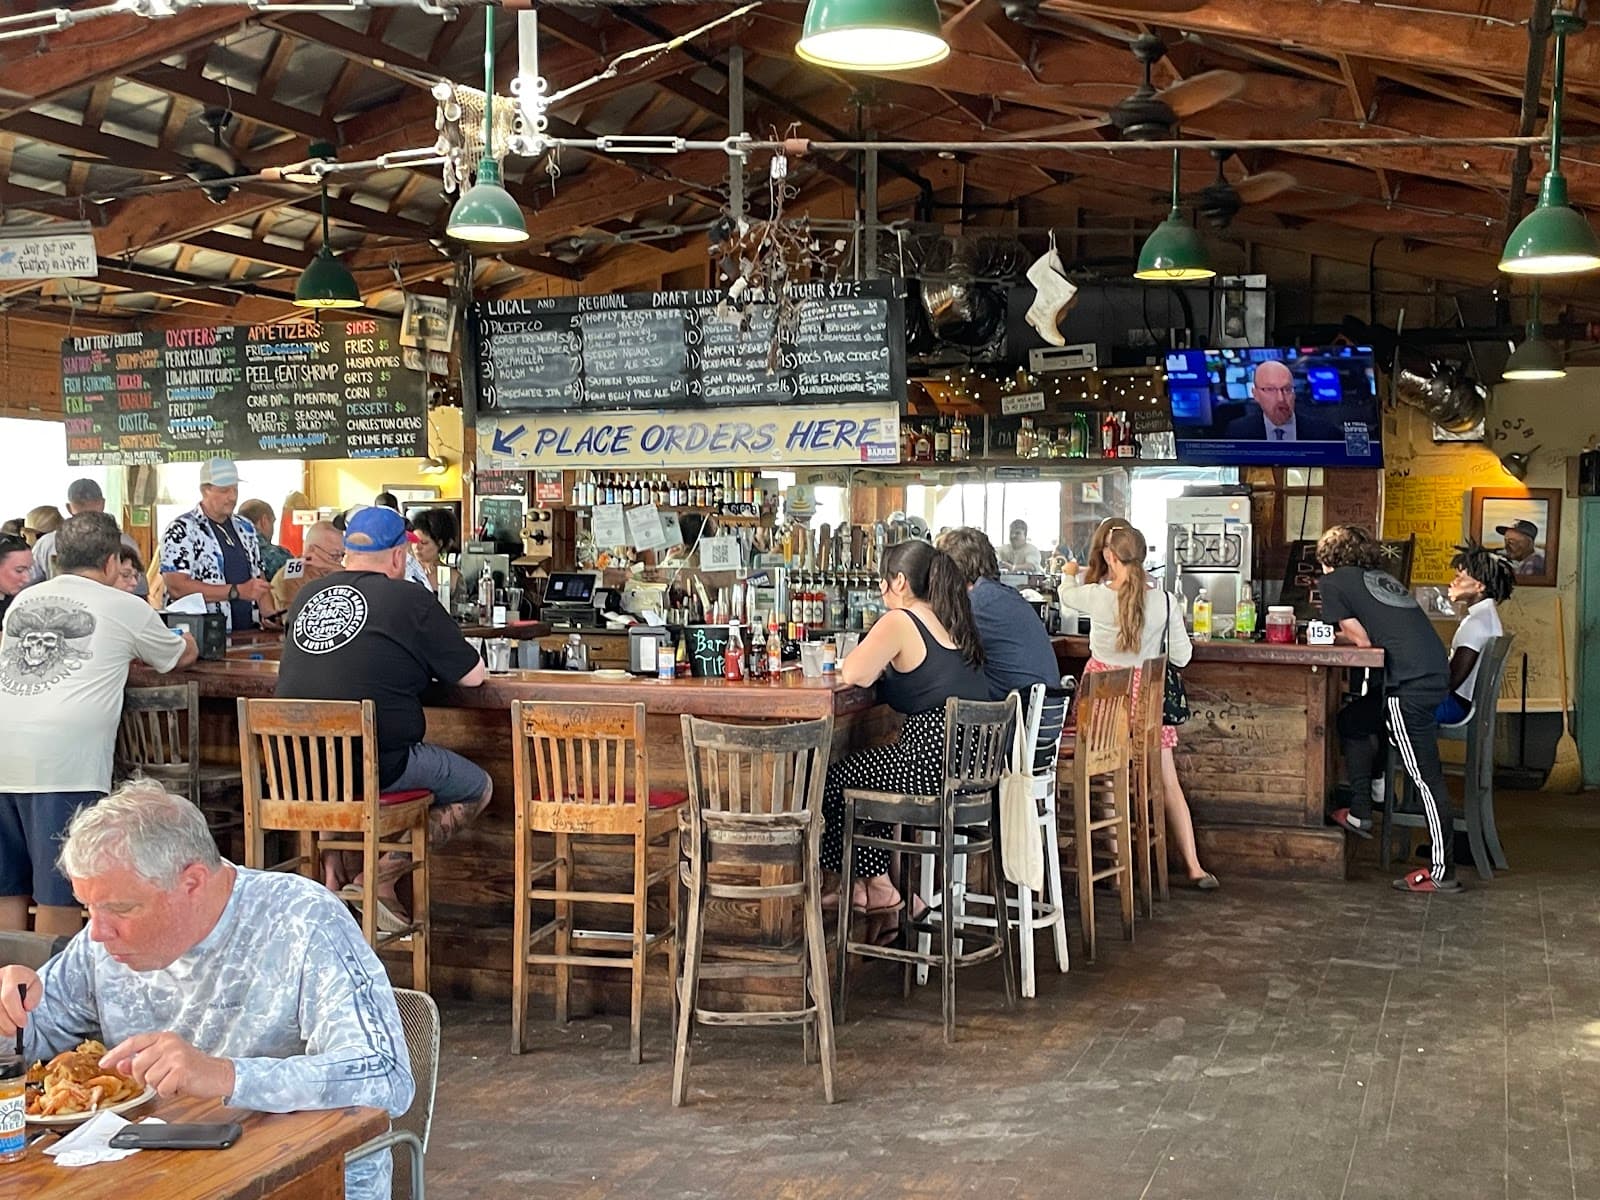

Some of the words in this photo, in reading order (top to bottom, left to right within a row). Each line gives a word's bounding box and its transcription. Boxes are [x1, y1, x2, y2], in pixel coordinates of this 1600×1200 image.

[487, 299, 532, 316] LOCAL
[537, 299, 556, 309] AND
[578, 294, 629, 312] REGIONAL
[652, 290, 689, 308] DRAFT
[695, 289, 722, 305] LIST
[828, 282, 852, 298] $27
[489, 320, 543, 334] PACIFICO
[165, 327, 217, 348] OYSTERS
[344, 338, 375, 355] FRIES
[823, 350, 846, 364] PEAR
[846, 350, 881, 363] CIDER
[245, 365, 275, 383] PEEL
[300, 363, 339, 382] SHRIMP
[343, 371, 374, 385] GRITS
[379, 370, 392, 382] $5
[344, 386, 371, 400] CORN
[685, 378, 702, 397] 12)
[168, 402, 194, 417] FRIED
[246, 411, 278, 425] BOILED
[294, 409, 337, 422] SEASONAL
[295, 420, 322, 432] SALAD
[346, 417, 396, 432] CHARLESTON
[1495, 417, 1536, 441] JOSH
[346, 434, 363, 446] KEY
[395, 432, 417, 445] SLICE
[534, 423, 635, 458] PLACE
[640, 420, 778, 456] ORDERS
[785, 417, 883, 453] HERE
[287, 561, 302, 574] 56
[1311, 626, 1332, 638] 153
[302, 638, 335, 650] AUSTIN
[692, 629, 728, 655] Bar
